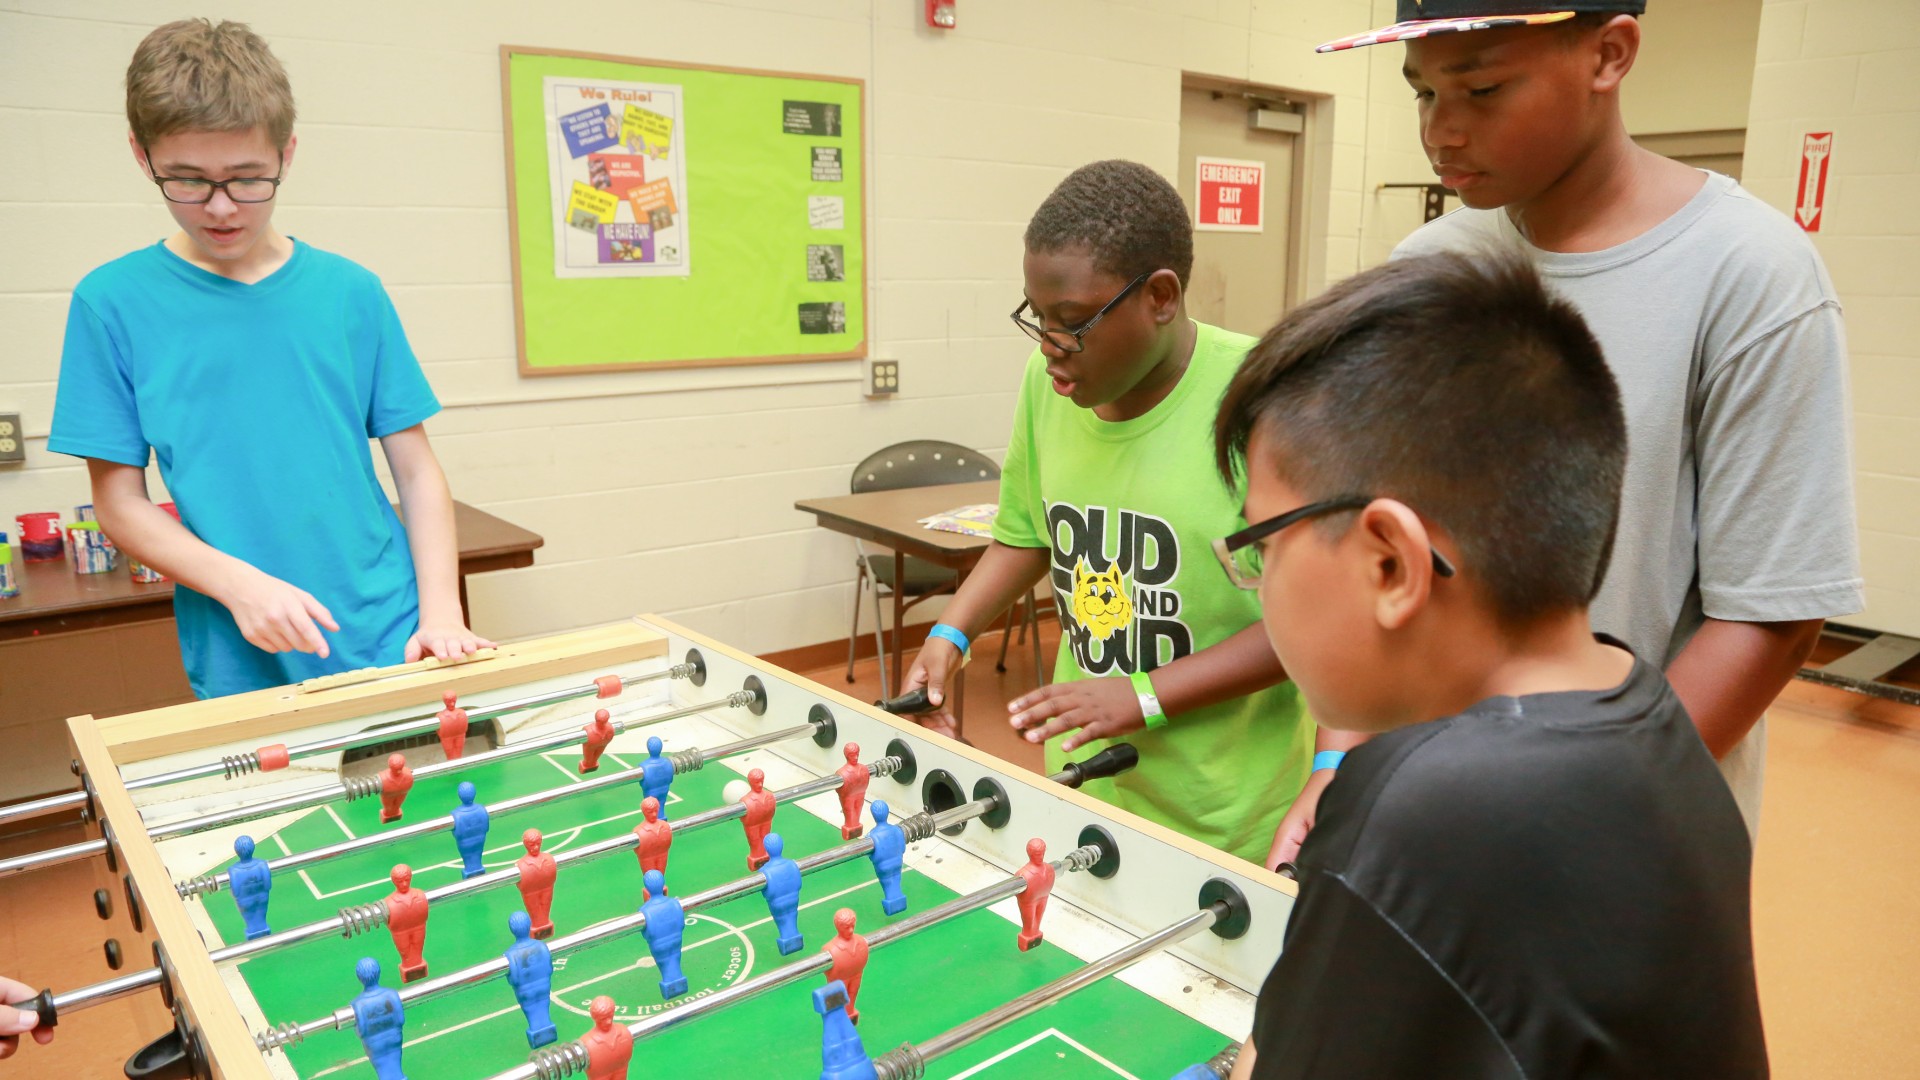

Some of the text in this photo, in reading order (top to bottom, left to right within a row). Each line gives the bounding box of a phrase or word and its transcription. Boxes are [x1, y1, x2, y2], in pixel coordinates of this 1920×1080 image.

[579, 87, 652, 102] We Rule!
[1805, 143, 1829, 153] FIRE
[1202, 164, 1259, 185] EMERGENCY
[1219, 186, 1241, 204] EXIT
[1218, 206, 1242, 224] ONLY
[603, 224, 615, 240] WE
[615, 224, 634, 240] HAVE
[1133, 585, 1179, 616] AND
[721, 946, 741, 981] soccer
